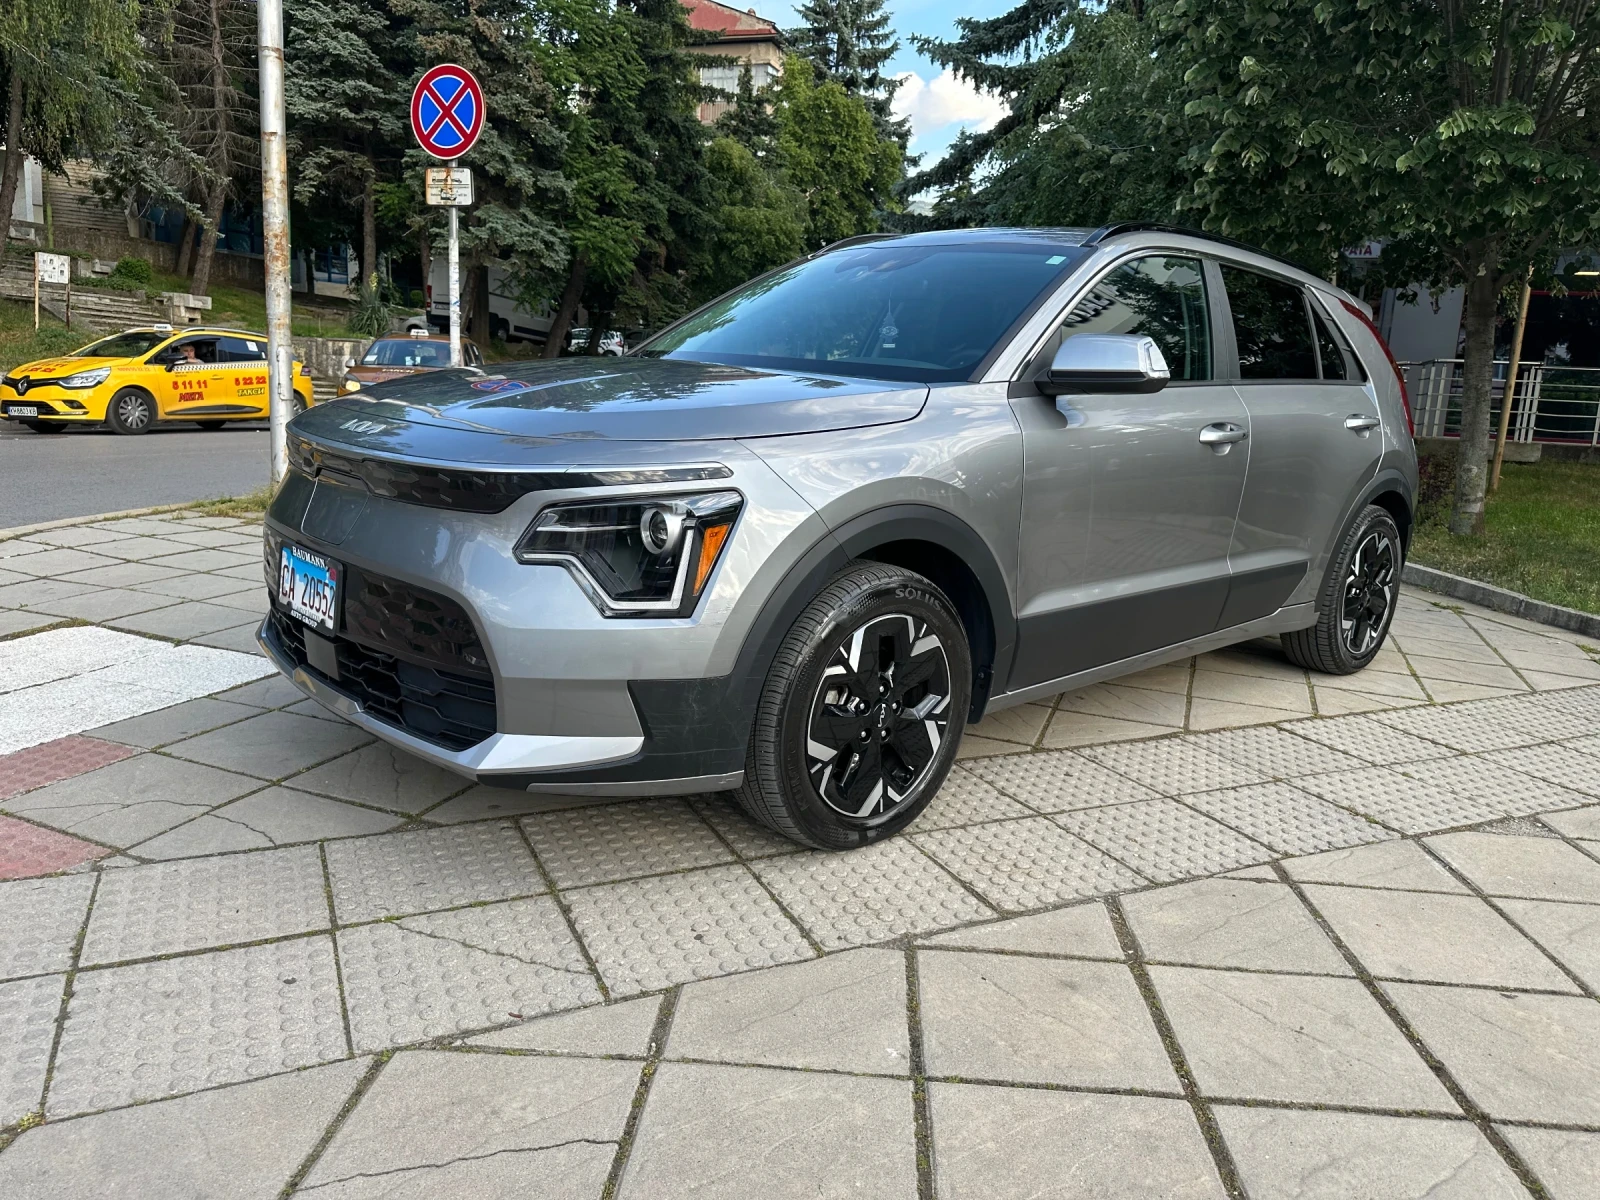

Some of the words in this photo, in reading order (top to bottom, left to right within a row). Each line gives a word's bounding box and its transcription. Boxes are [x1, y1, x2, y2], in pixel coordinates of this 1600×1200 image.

[182, 381, 193, 390] 11
[196, 380, 208, 389] 11
[242, 377, 254, 386] 22
[255, 376, 267, 385] 22
[237, 387, 265, 398] ТАКСИ
[292, 546, 325, 568] BAUMANN
[282, 565, 295, 600] CA
[302, 573, 335, 620] 20552
